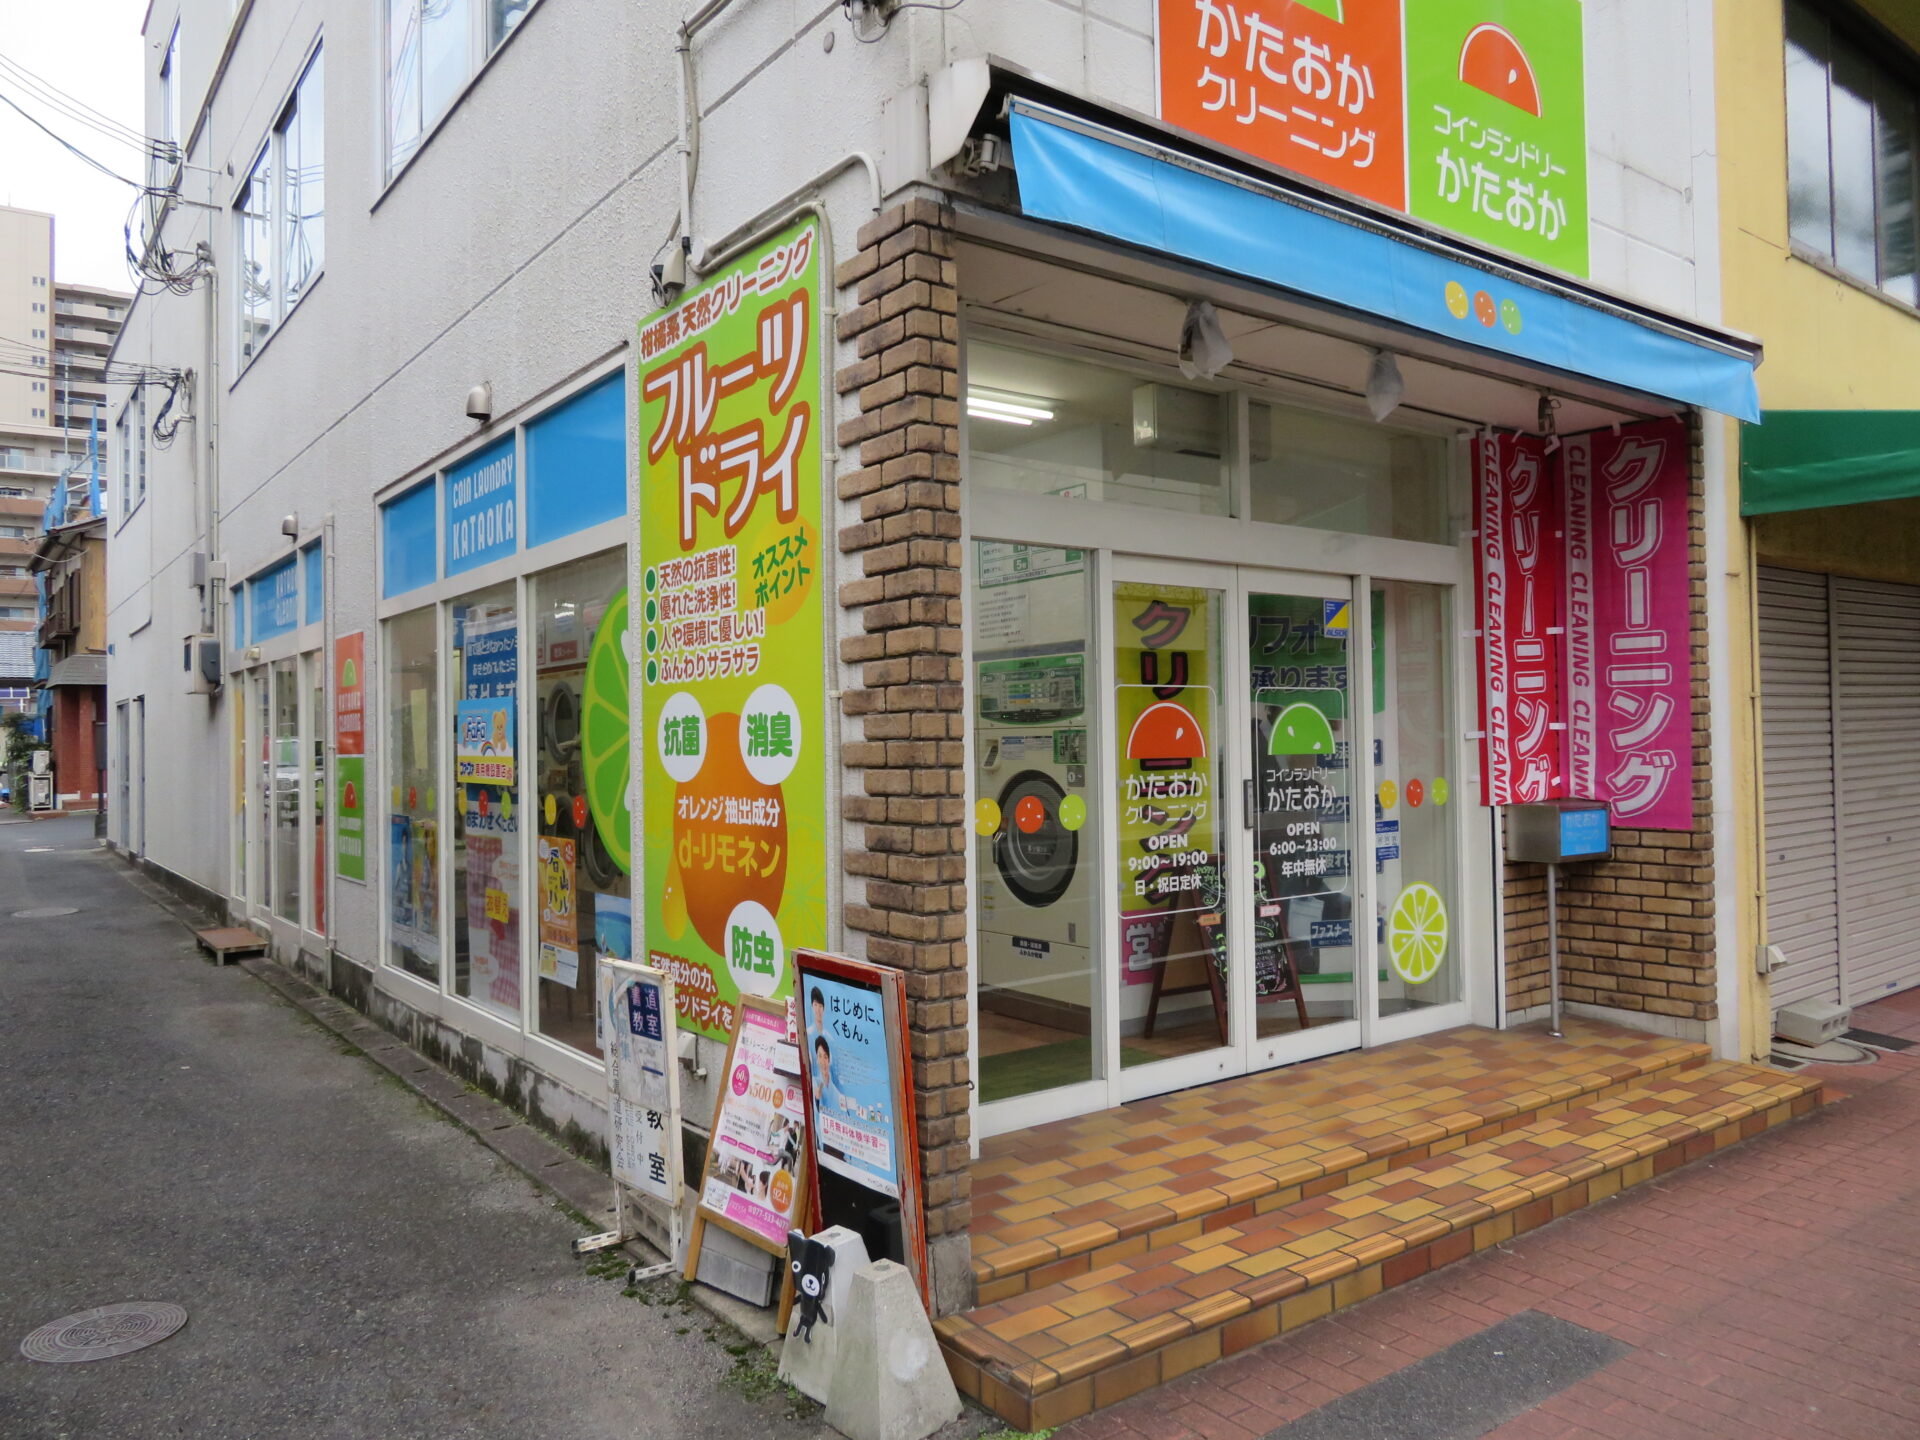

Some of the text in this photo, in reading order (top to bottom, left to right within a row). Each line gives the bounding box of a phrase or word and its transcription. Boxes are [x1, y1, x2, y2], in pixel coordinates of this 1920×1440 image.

[1195, 0, 1375, 115] かたおか
[1197, 66, 1376, 168] クリーニング
[1433, 105, 1567, 177] コインランドリー
[1436, 147, 1567, 241] かたおか
[682, 230, 813, 337] 天然クリーニング
[645, 299, 804, 456] フルーツ
[453, 453, 513, 509] COIN LAUNDRY
[682, 413, 804, 541] ドライ
[1484, 439, 1501, 561] CLEANING
[1568, 444, 1587, 561] CLEANING
[453, 499, 514, 560] KATAOKA
[752, 527, 808, 580] オススメ
[755, 560, 811, 608] ポイント
[1487, 571, 1504, 693] CLEANING
[1506, 446, 1551, 803] クリーニング
[1571, 571, 1590, 688] CLEANING
[1602, 436, 1677, 819] クリーニング
[661, 646, 759, 681] ふんわりサラサラ
[664, 714, 700, 756] 抗菌
[747, 711, 793, 758] 消臭
[1126, 771, 1209, 801] かたおか
[1266, 767, 1337, 783] コインランドリー
[1267, 784, 1337, 812] かたおか
[678, 795, 780, 828] オレンジ抽出成分
[1126, 800, 1208, 825] クリーニング
[1287, 821, 1321, 837] OPEN
[1148, 833, 1189, 851] OPEN
[1281, 857, 1327, 879] 年中無休
[1134, 873, 1204, 896] 日・祝日定休
[732, 925, 776, 978] 防虫
[830, 994, 881, 1025] はじめに、
[832, 1021, 870, 1046] くもん。
